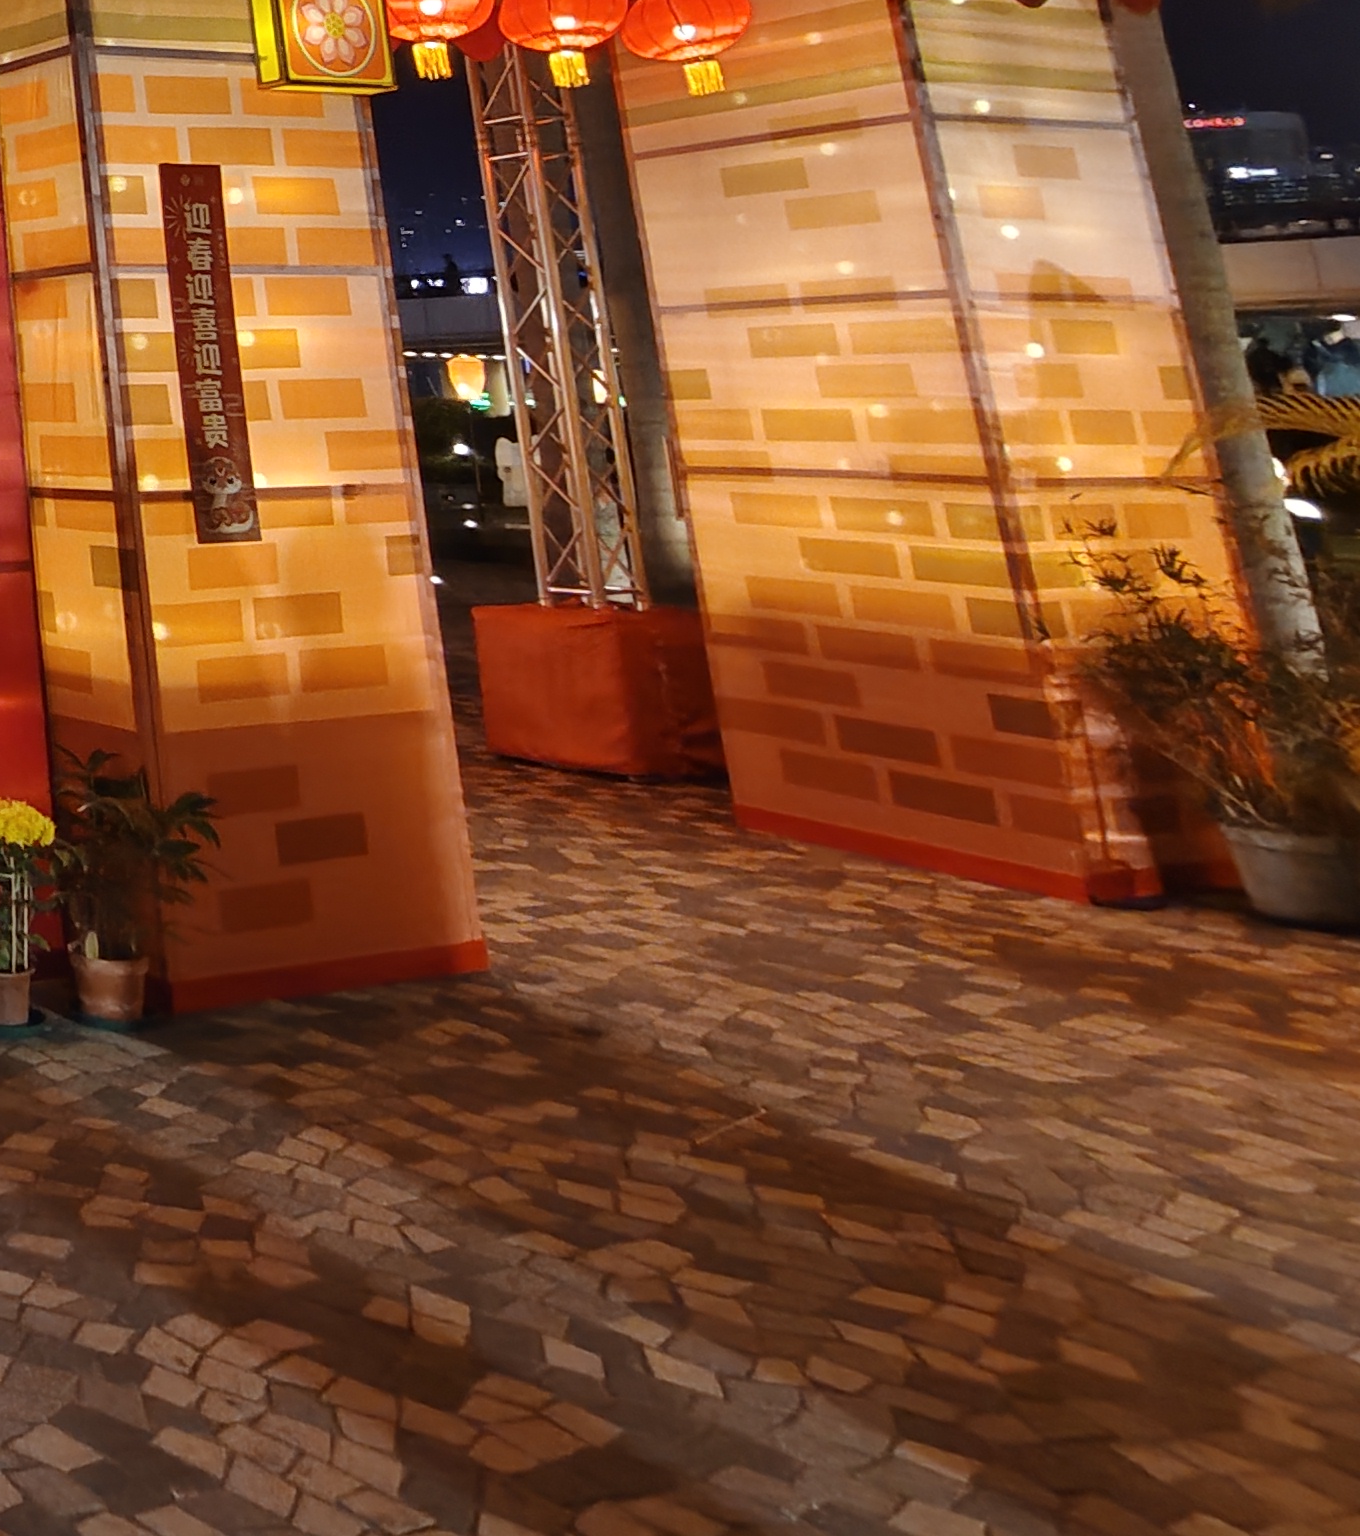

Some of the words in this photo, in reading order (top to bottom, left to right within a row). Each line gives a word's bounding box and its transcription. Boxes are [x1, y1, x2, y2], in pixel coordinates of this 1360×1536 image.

[184, 202, 229, 450] 迎春迎喜迎富贵
